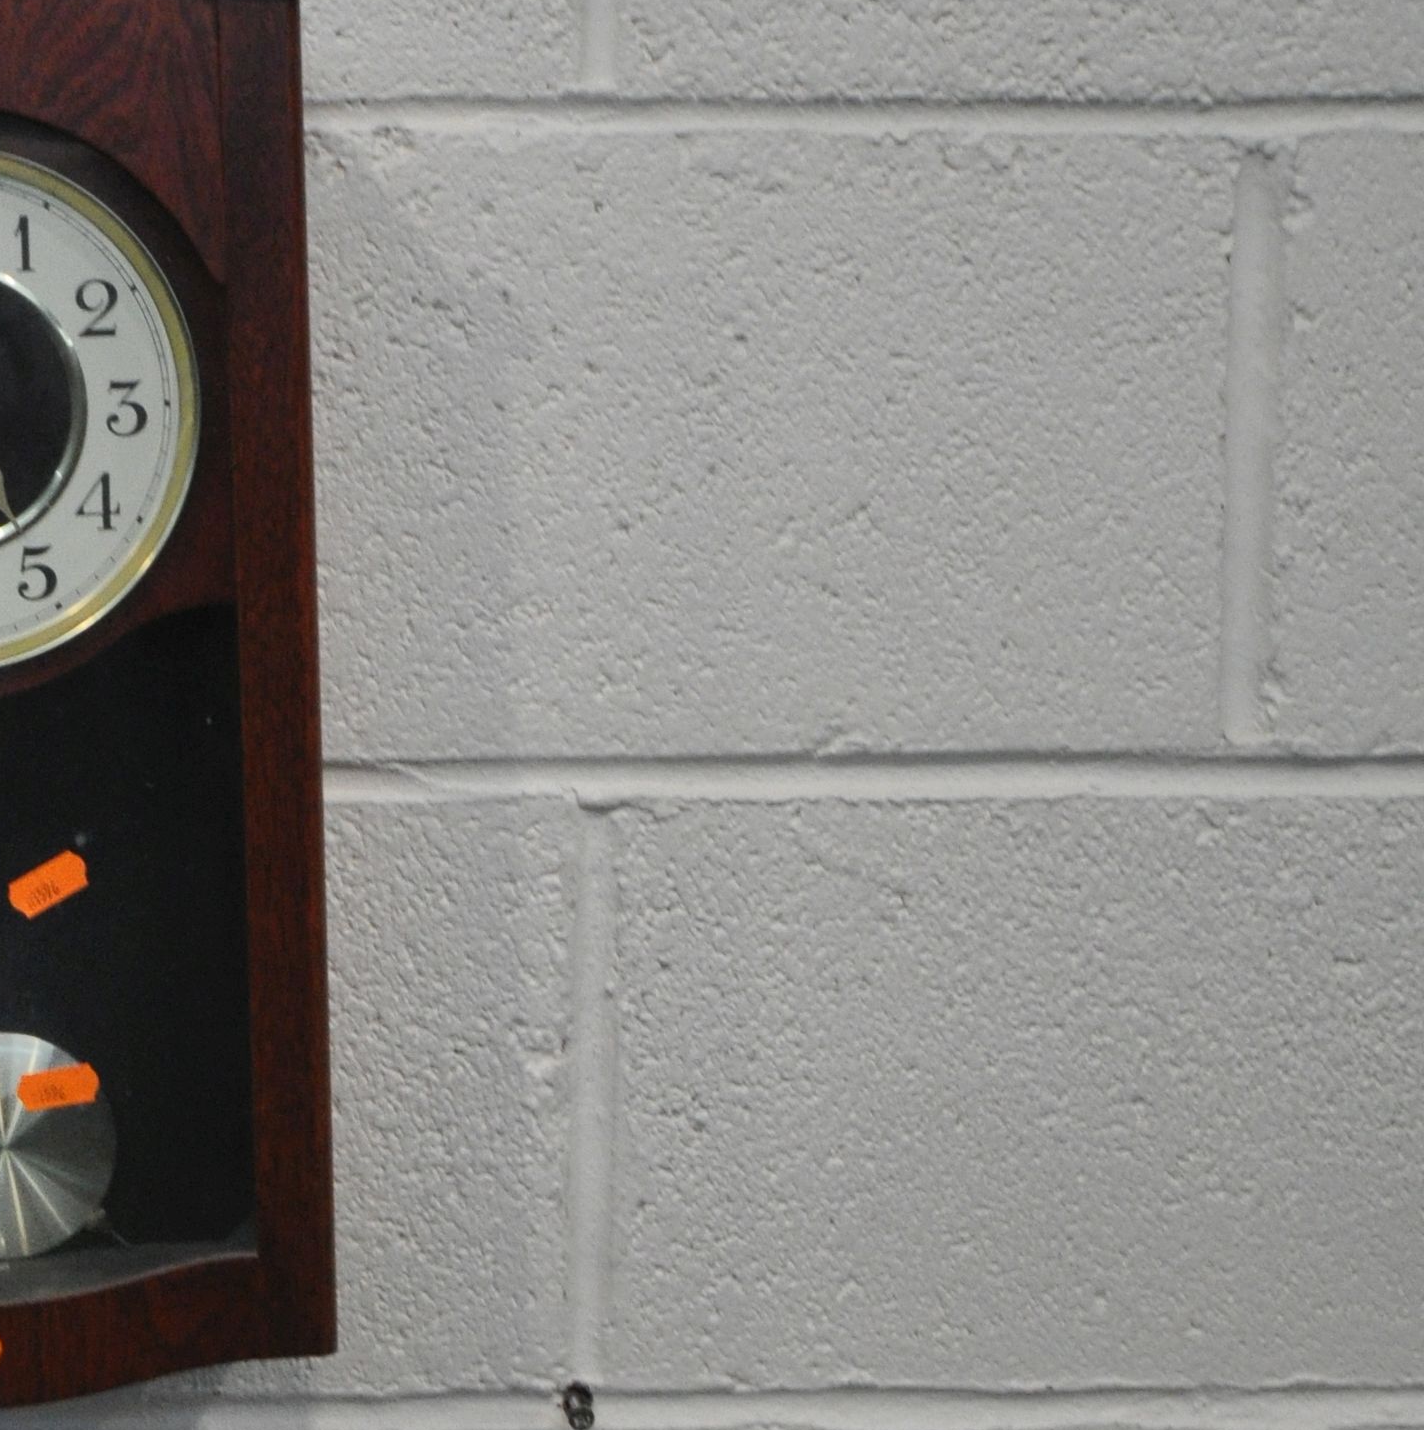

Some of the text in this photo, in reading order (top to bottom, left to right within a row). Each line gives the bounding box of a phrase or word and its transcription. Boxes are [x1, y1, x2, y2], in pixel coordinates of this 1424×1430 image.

[14, 215, 35, 273] 1
[76, 279, 118, 337] 2
[106, 380, 148, 436] 3
[76, 472, 121, 531] 4
[17, 546, 57, 600] 5
